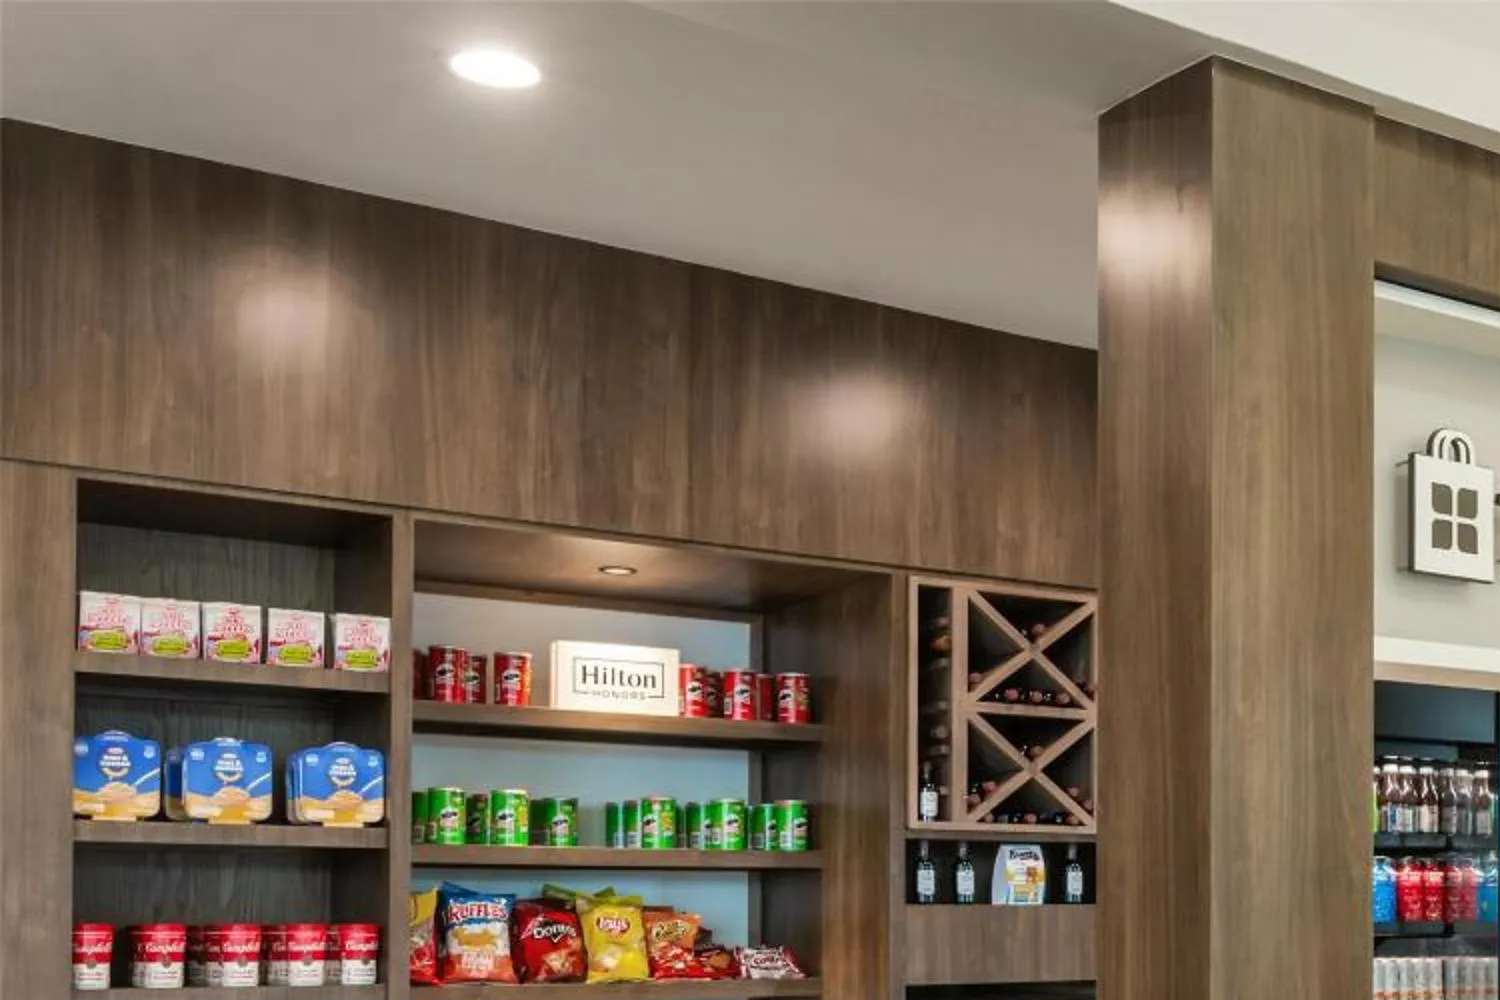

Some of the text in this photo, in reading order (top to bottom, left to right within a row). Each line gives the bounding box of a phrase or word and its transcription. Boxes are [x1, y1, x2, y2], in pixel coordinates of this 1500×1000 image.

[582, 664, 656, 688] Hilton
[448, 901, 509, 923] RUFFLES
[532, 922, 577, 942] Doritos
